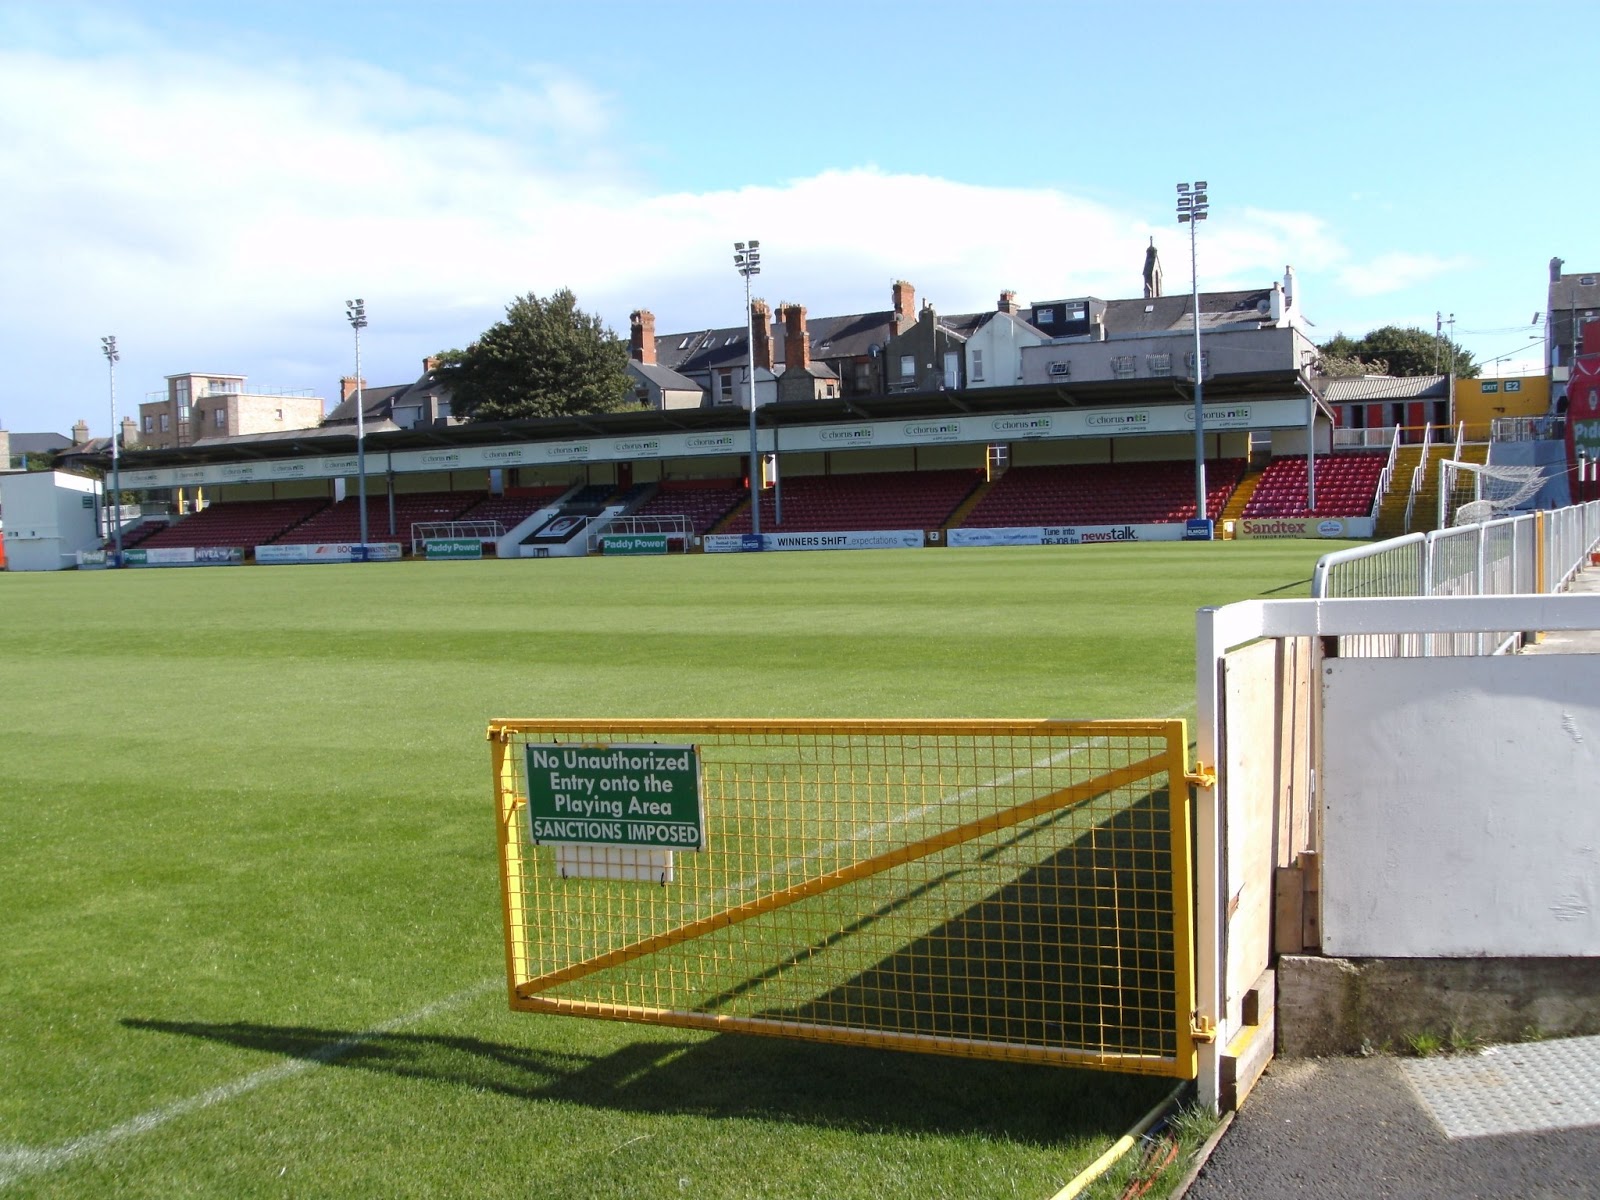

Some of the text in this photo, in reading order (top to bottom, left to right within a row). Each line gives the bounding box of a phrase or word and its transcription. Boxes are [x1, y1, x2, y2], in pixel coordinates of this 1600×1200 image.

[1506, 381, 1519, 390] E2
[1096, 414, 1125, 424] chorus
[1002, 420, 1029, 429] chorus
[913, 426, 938, 434] chorus
[828, 431, 853, 439] chorus
[693, 438, 716, 446] chorus
[1043, 527, 1076, 536] Tune into
[1243, 520, 1306, 534] Sandtex
[604, 539, 665, 550] Paddy Power
[777, 537, 819, 546] WINNERS
[427, 543, 479, 553] Paddy Power
[83, 552, 105, 561] Paddy
[125, 552, 147, 561] Power
[196, 550, 219, 559] NIVEA
[533, 750, 690, 771] No Unauthorized
[550, 772, 673, 795] Entry onto the
[555, 793, 672, 818] Playing Area
[534, 820, 699, 843] SANCTIONS IMPOSED
